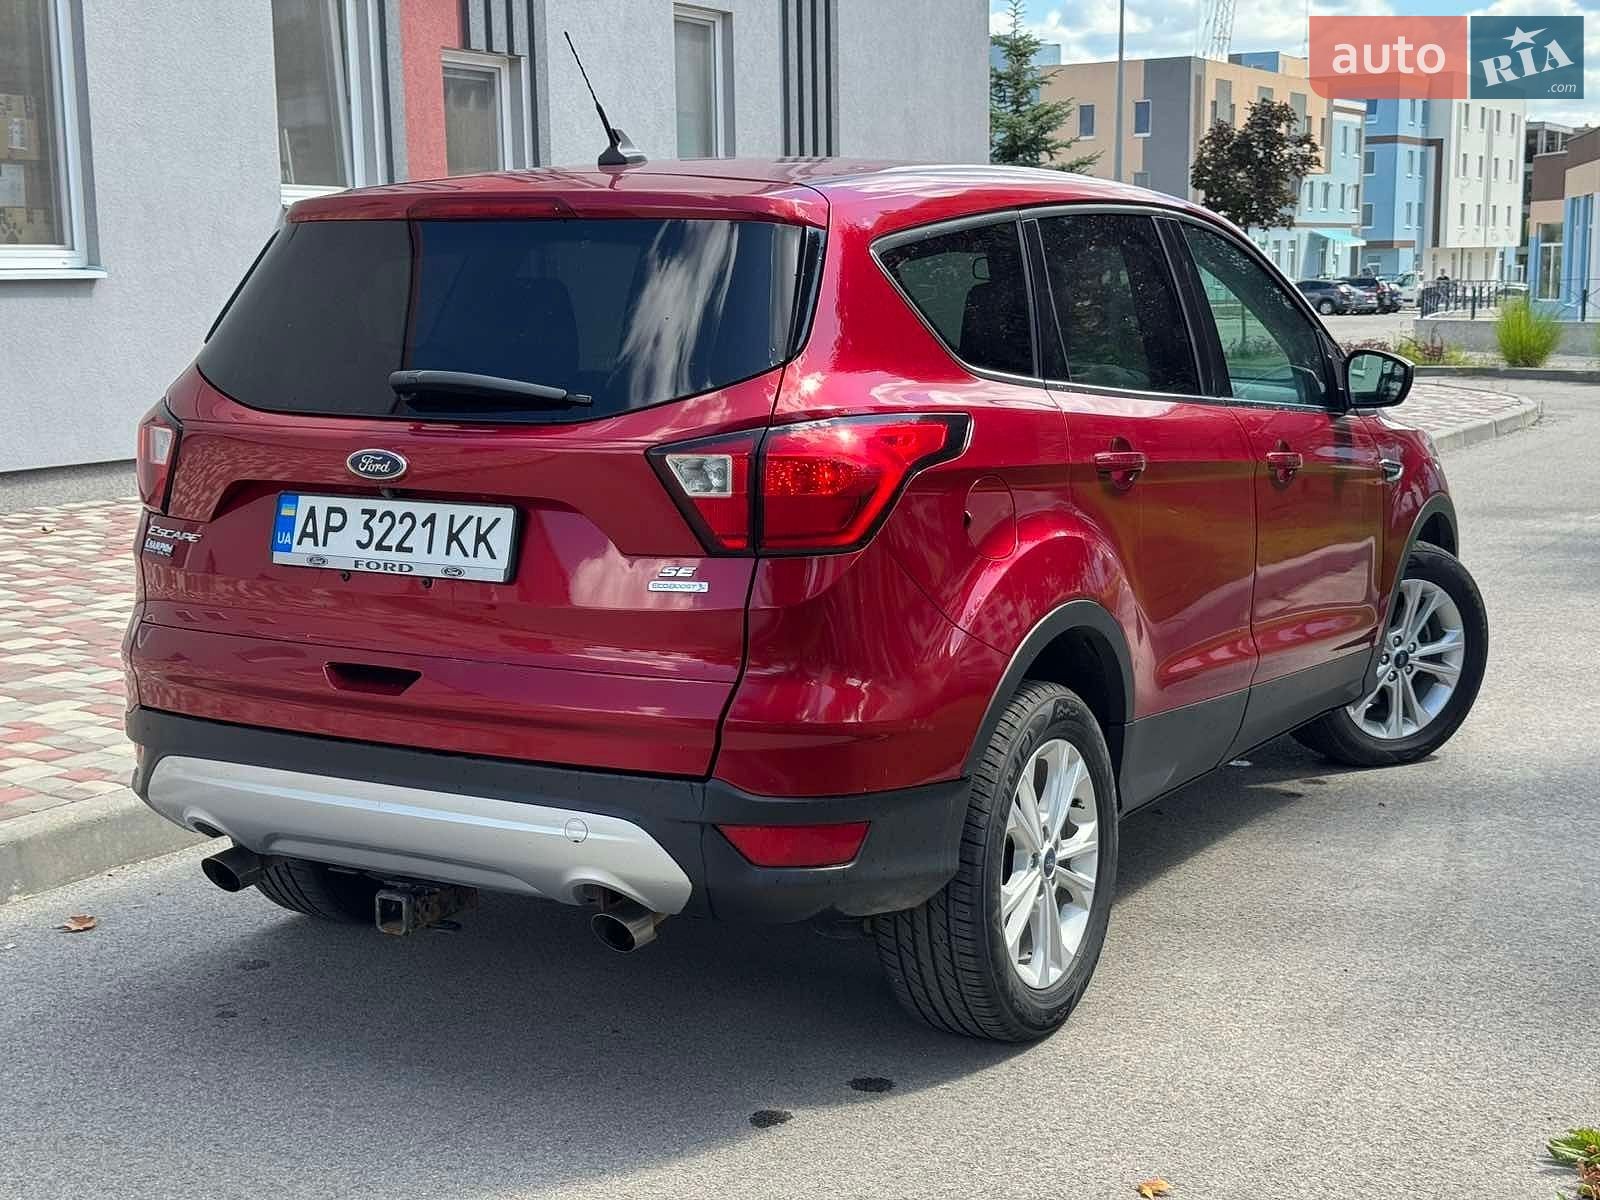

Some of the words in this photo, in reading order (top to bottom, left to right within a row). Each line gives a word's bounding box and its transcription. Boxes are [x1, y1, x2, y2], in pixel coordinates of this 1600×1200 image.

[358, 454, 391, 473] Ford
[147, 525, 203, 543] ESCAPE
[277, 532, 292, 545] UA
[296, 505, 348, 548] AP
[355, 508, 437, 555] 3221
[445, 513, 502, 560] KK
[353, 558, 414, 573] FORD
[658, 566, 698, 578] SE
